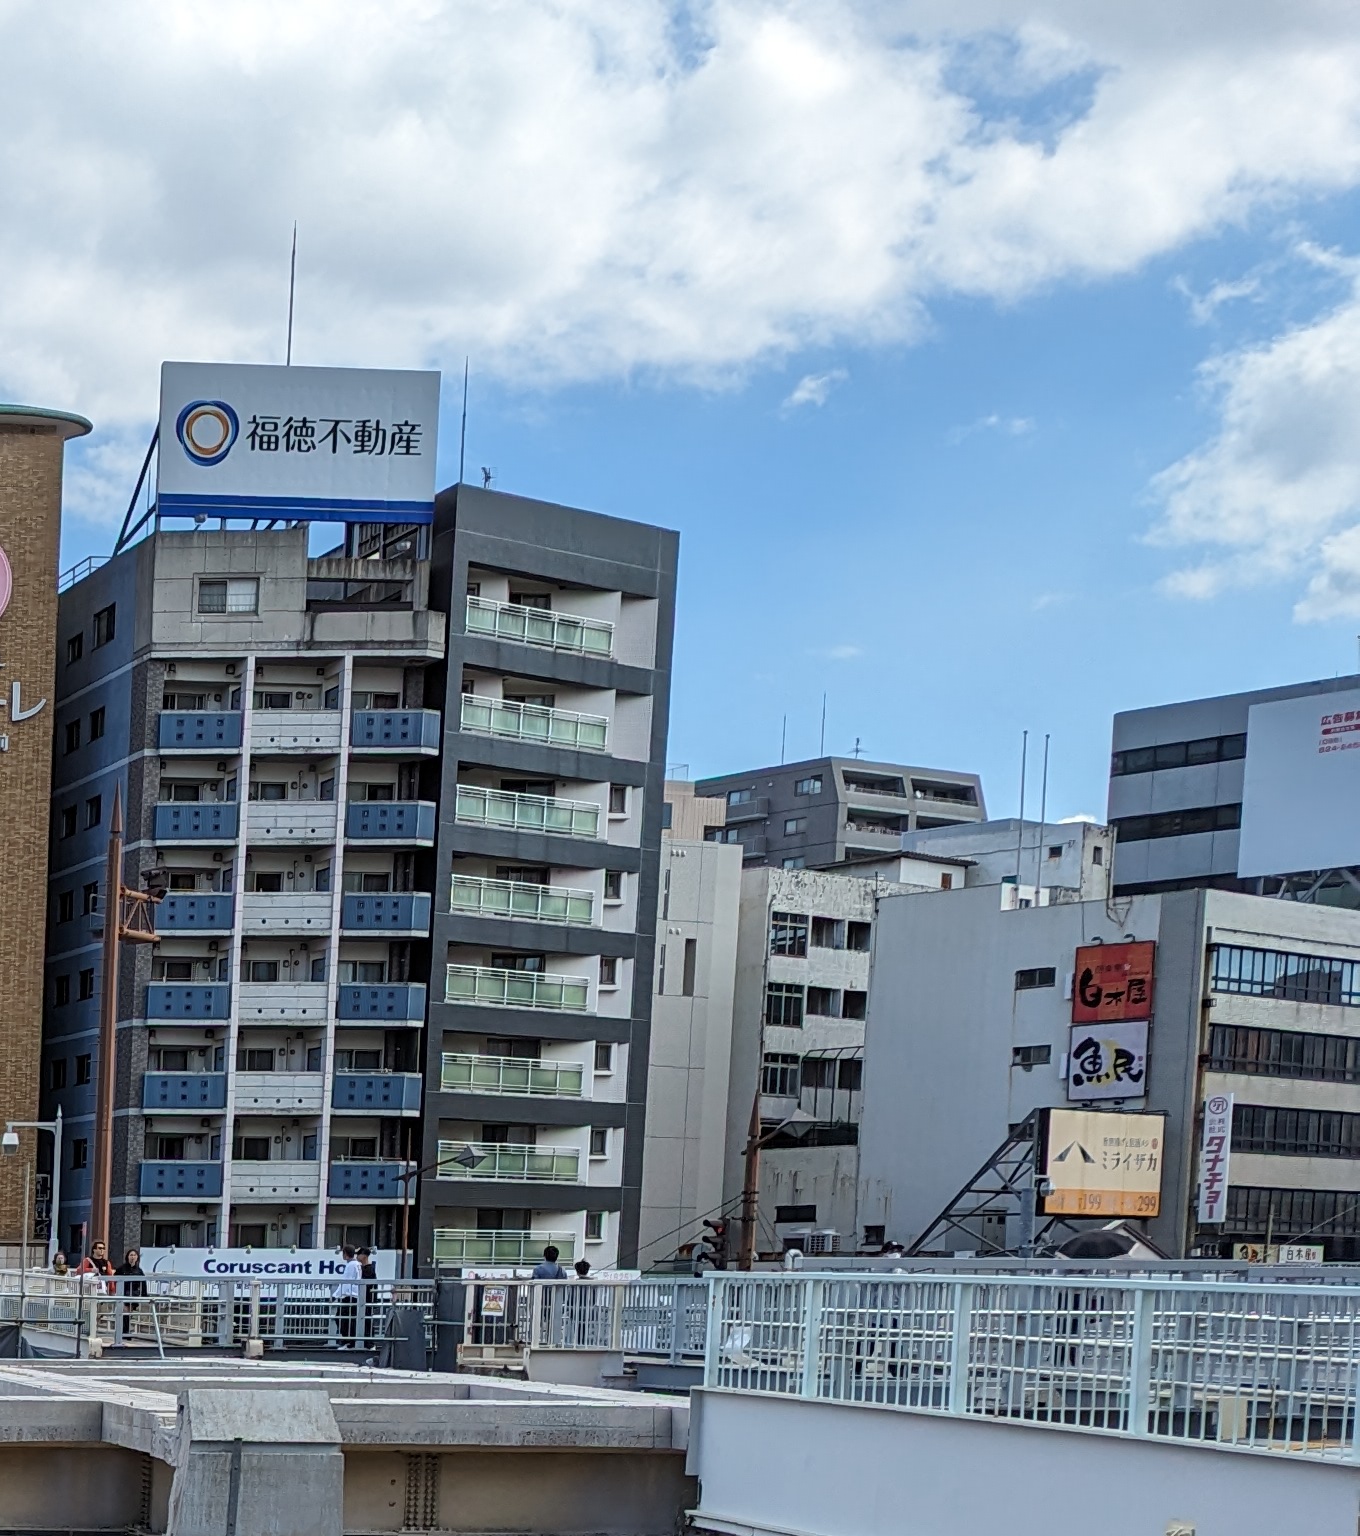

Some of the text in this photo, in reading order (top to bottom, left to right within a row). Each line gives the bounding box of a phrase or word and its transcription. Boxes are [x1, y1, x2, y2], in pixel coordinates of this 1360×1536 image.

[246, 415, 423, 456] 福徳不動産
[1079, 967, 1147, 1008] 白木屋
[1073, 1036, 1143, 1086] 魚民
[1101, 1151, 1158, 1172] ミライザカ
[1204, 1136, 1226, 1219] タナチョー
[204, 1259, 312, 1275] Coruscant
